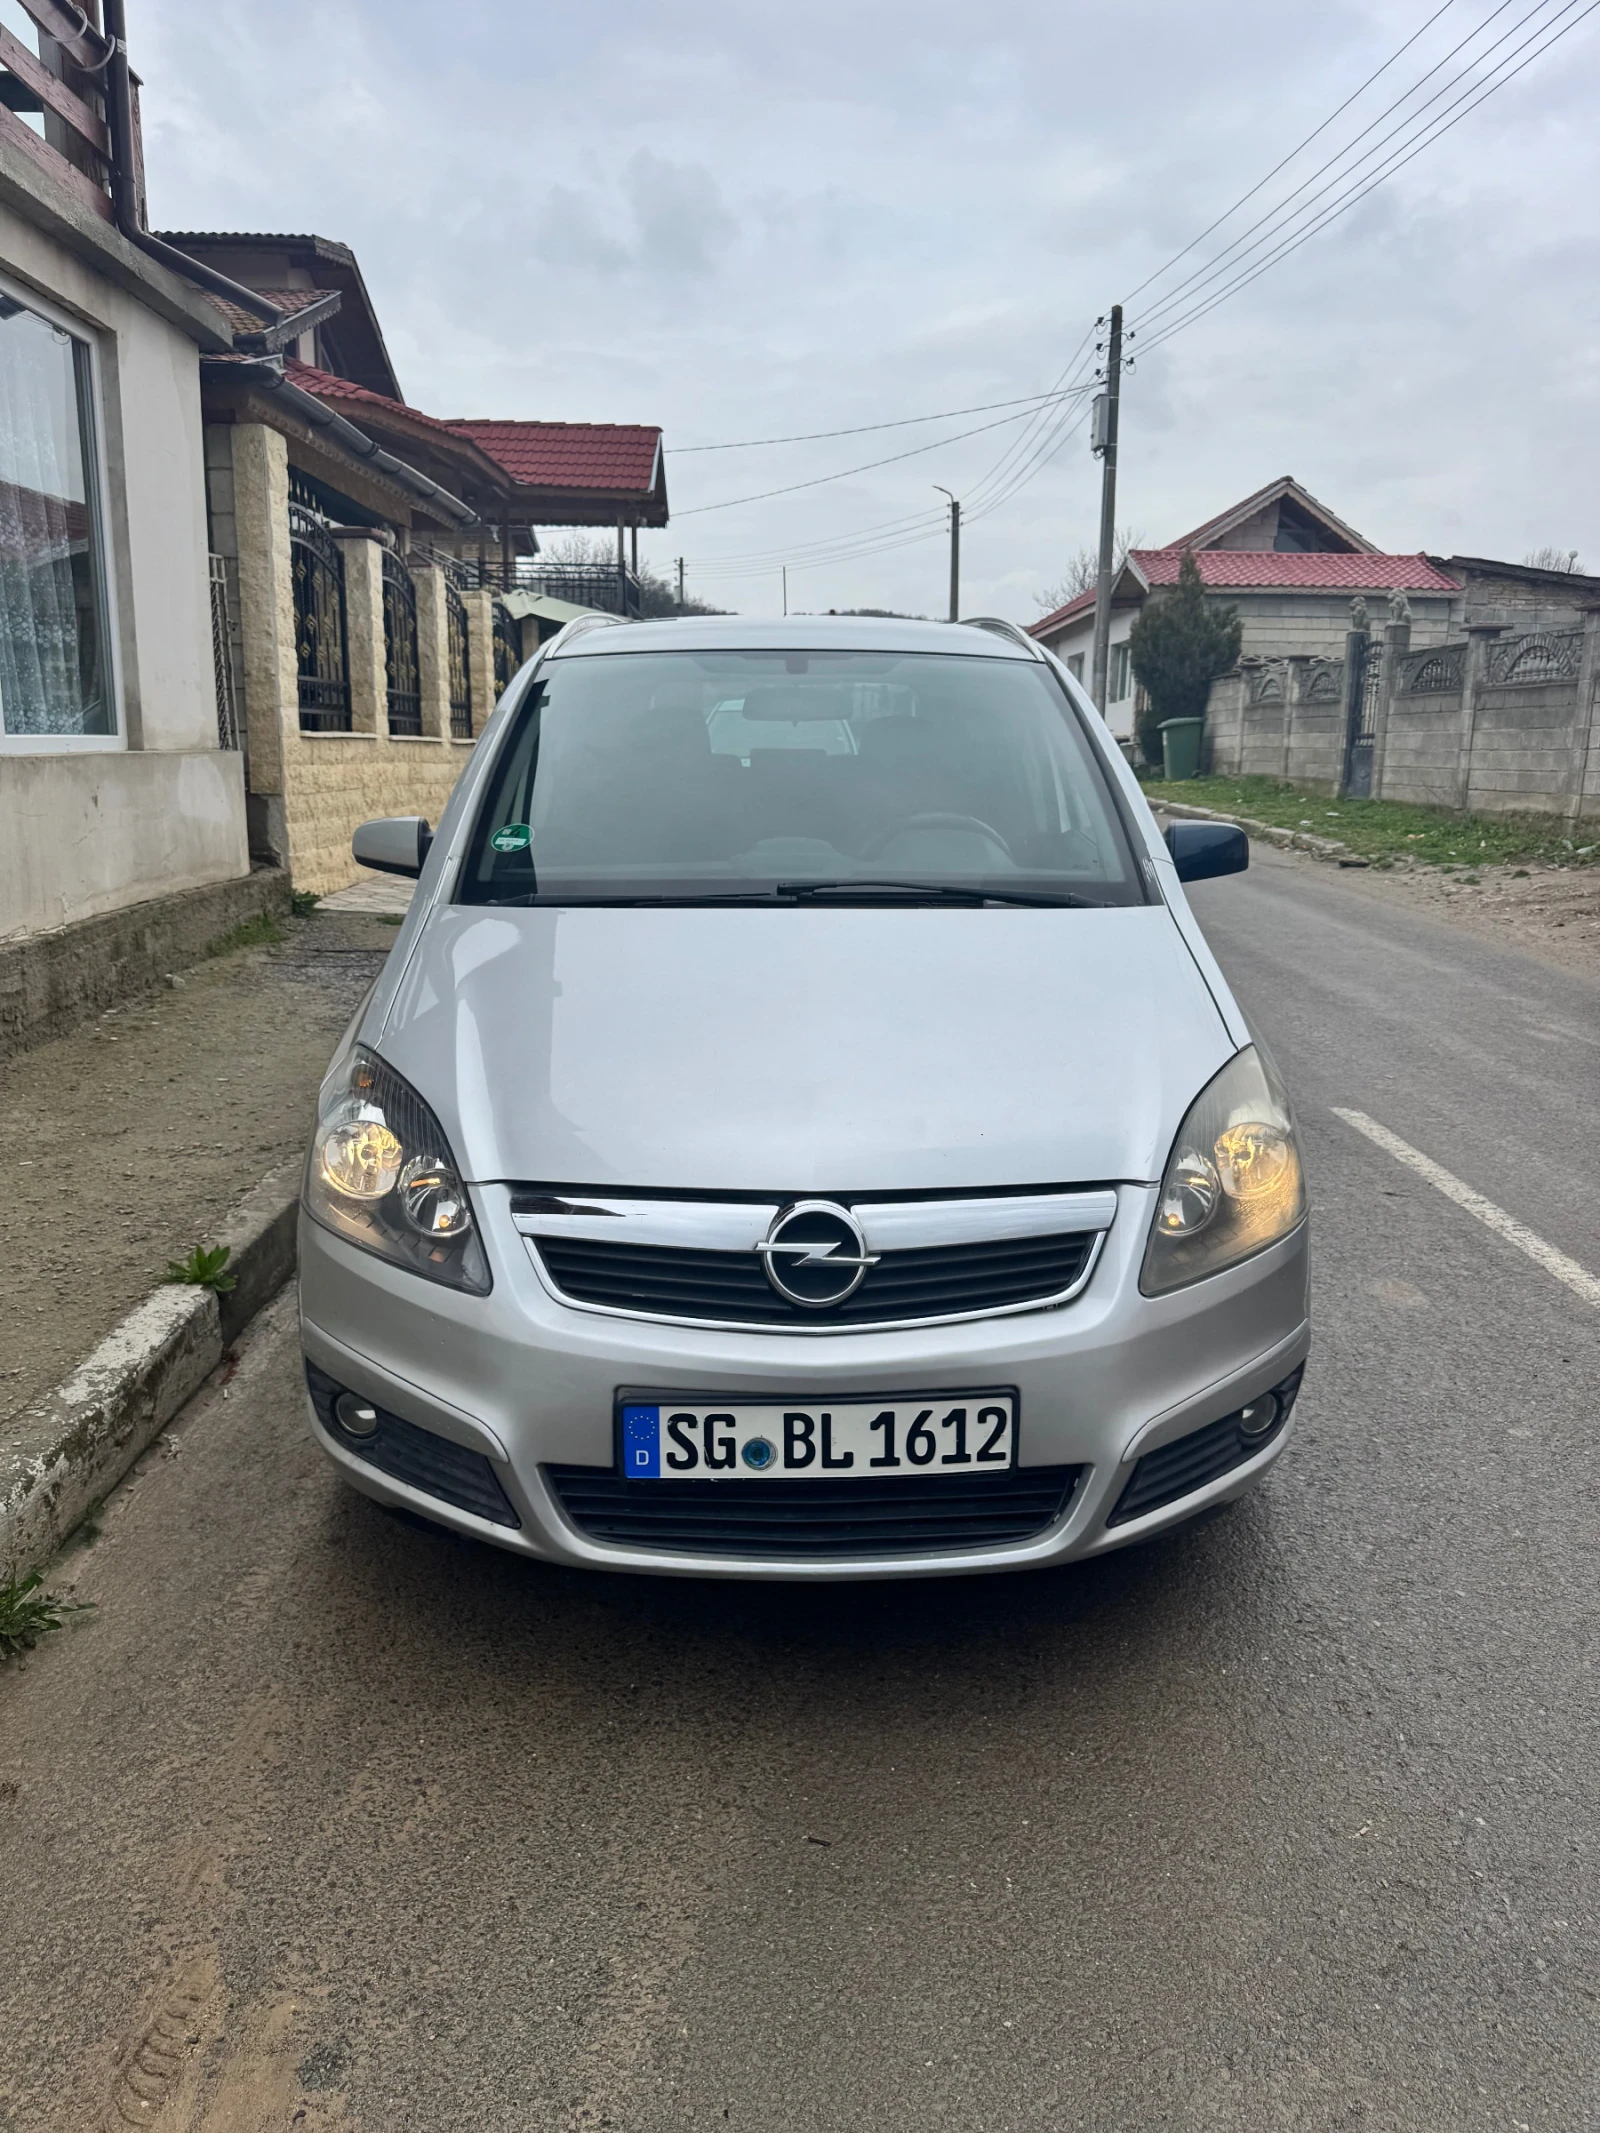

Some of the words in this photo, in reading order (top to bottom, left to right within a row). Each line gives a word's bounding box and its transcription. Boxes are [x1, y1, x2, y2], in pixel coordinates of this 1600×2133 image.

[509, 825, 521, 837] 4
[666, 1413, 736, 1470] SG
[783, 1412, 854, 1469] BL
[869, 1406, 1008, 1467] 1612
[636, 1450, 649, 1465] D
